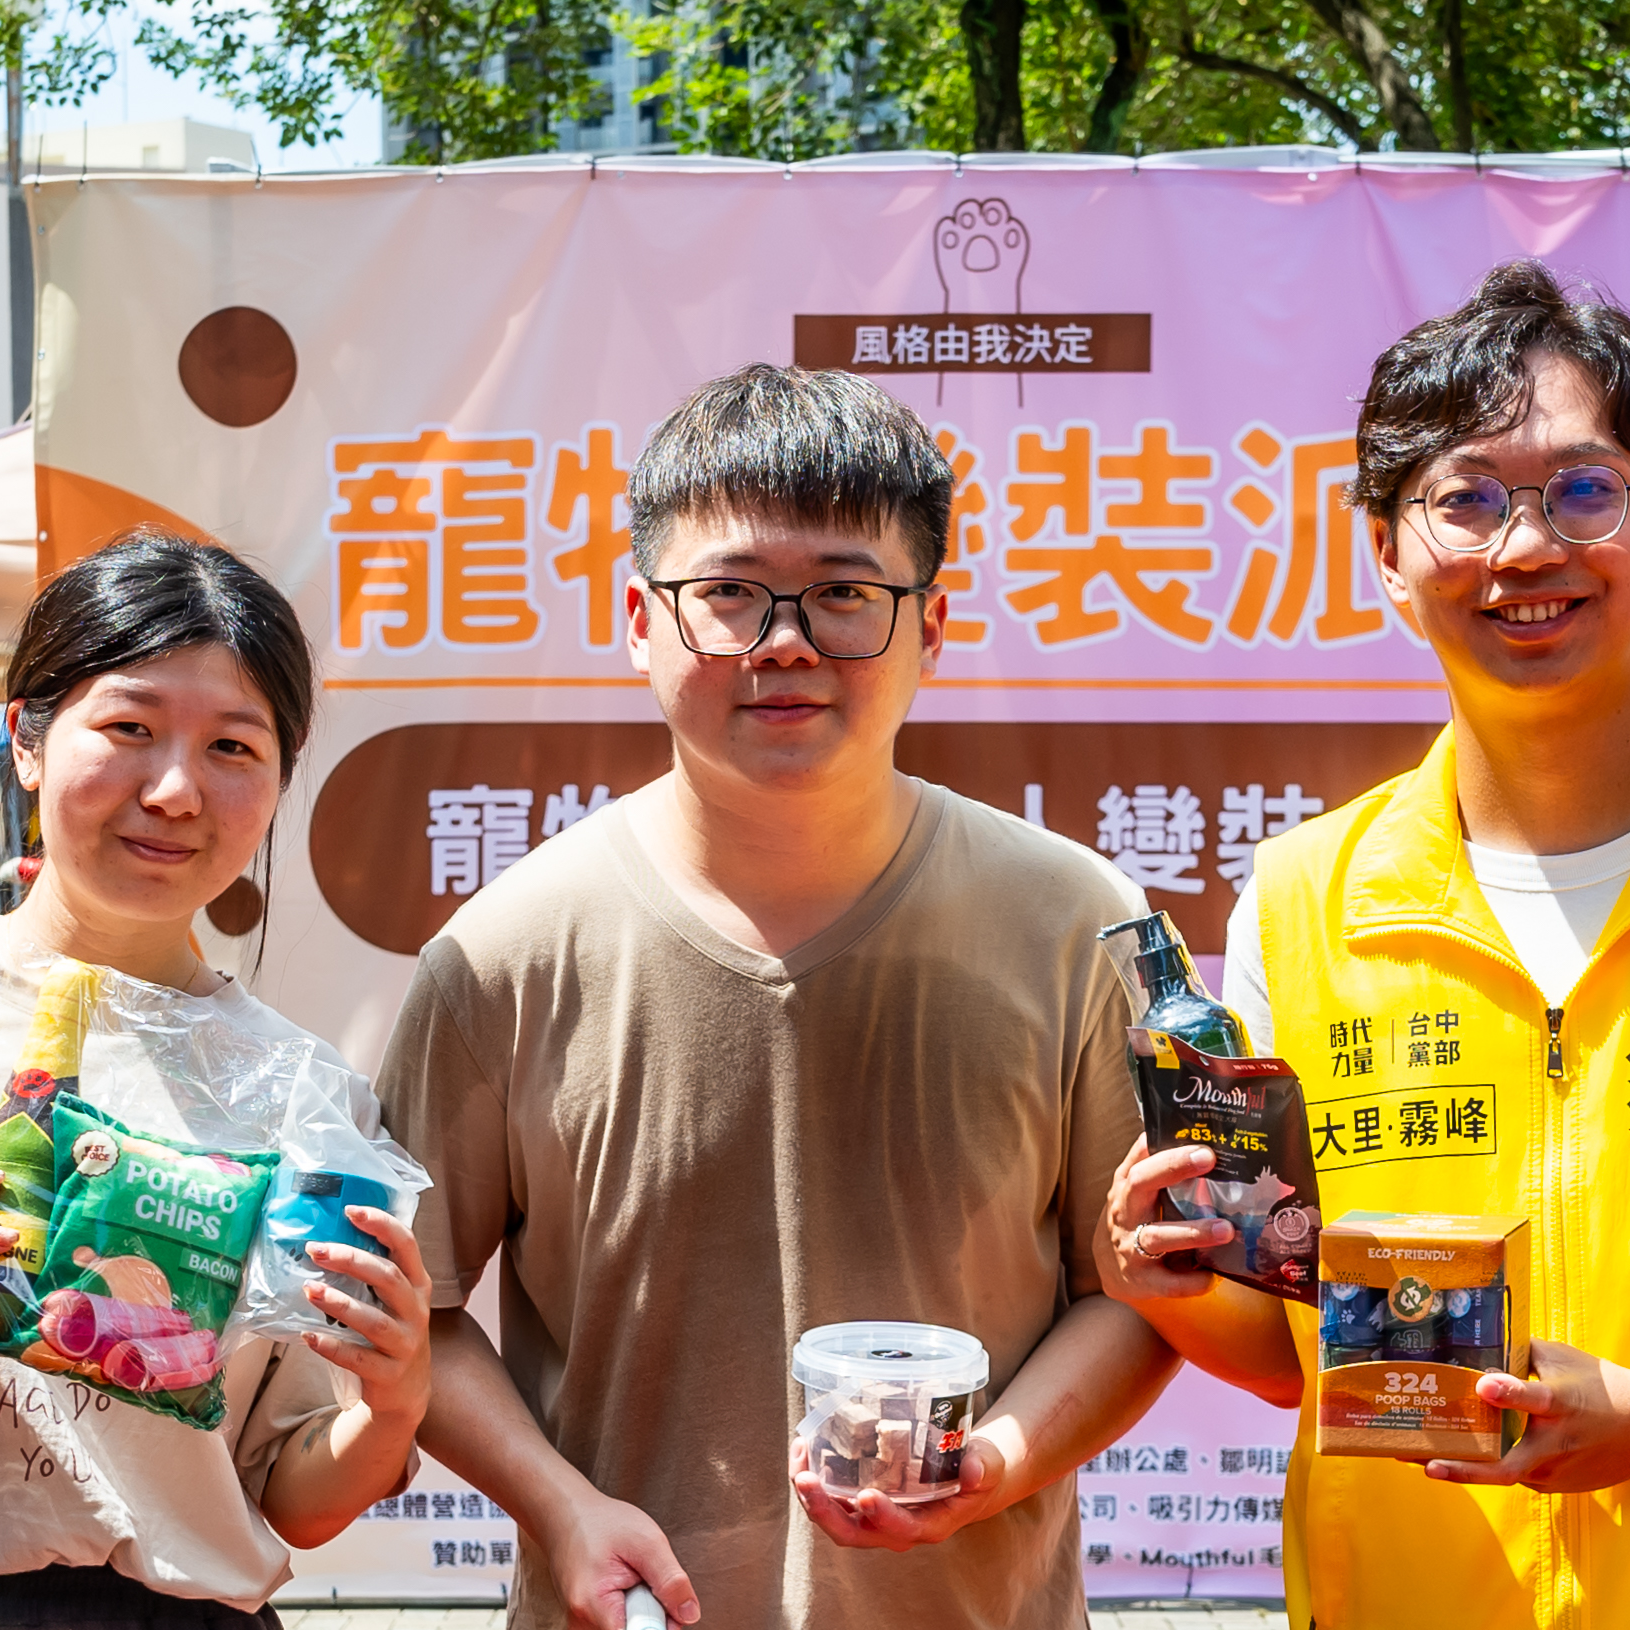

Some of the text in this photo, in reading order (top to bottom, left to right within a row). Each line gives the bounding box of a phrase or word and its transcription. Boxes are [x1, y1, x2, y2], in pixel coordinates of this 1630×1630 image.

[851, 322, 1093, 365] 風格由我決定
[1330, 1017, 1373, 1048] 時代
[1407, 1009, 1459, 1037] 台中
[1331, 1047, 1374, 1078] 力量
[1407, 1039, 1461, 1068] 黨部
[1173, 1076, 1267, 1116] Mouthful
[1241, 1136, 1268, 1152] 15%
[126, 1159, 238, 1215] POTATO
[135, 1194, 222, 1241] CHIPS
[188, 1253, 239, 1283] BACON
[1367, 1247, 1456, 1262] ECO-FRIENDLY
[1384, 1371, 1439, 1395] 324
[1375, 1394, 1447, 1408] POOP BAGS
[1402, 1406, 1432, 1416] ROLLS
[20, 1446, 94, 1483] YOU
